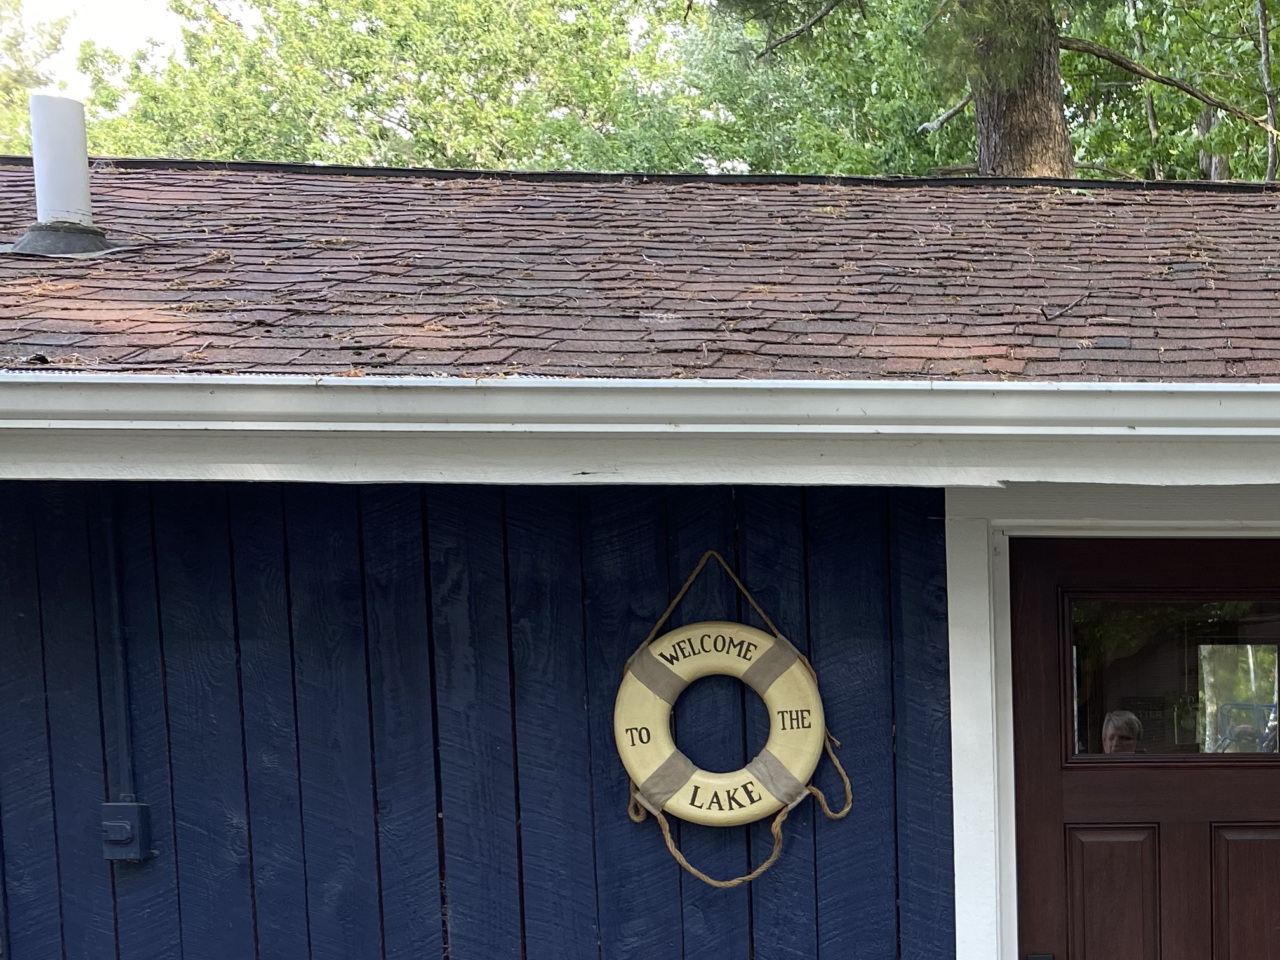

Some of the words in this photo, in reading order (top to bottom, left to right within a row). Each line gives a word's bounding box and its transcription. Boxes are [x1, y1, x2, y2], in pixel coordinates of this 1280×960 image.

[658, 634, 757, 667] WELCOME
[625, 726, 651, 747] TO
[777, 709, 812, 731] THE
[689, 780, 762, 812] LAKE
